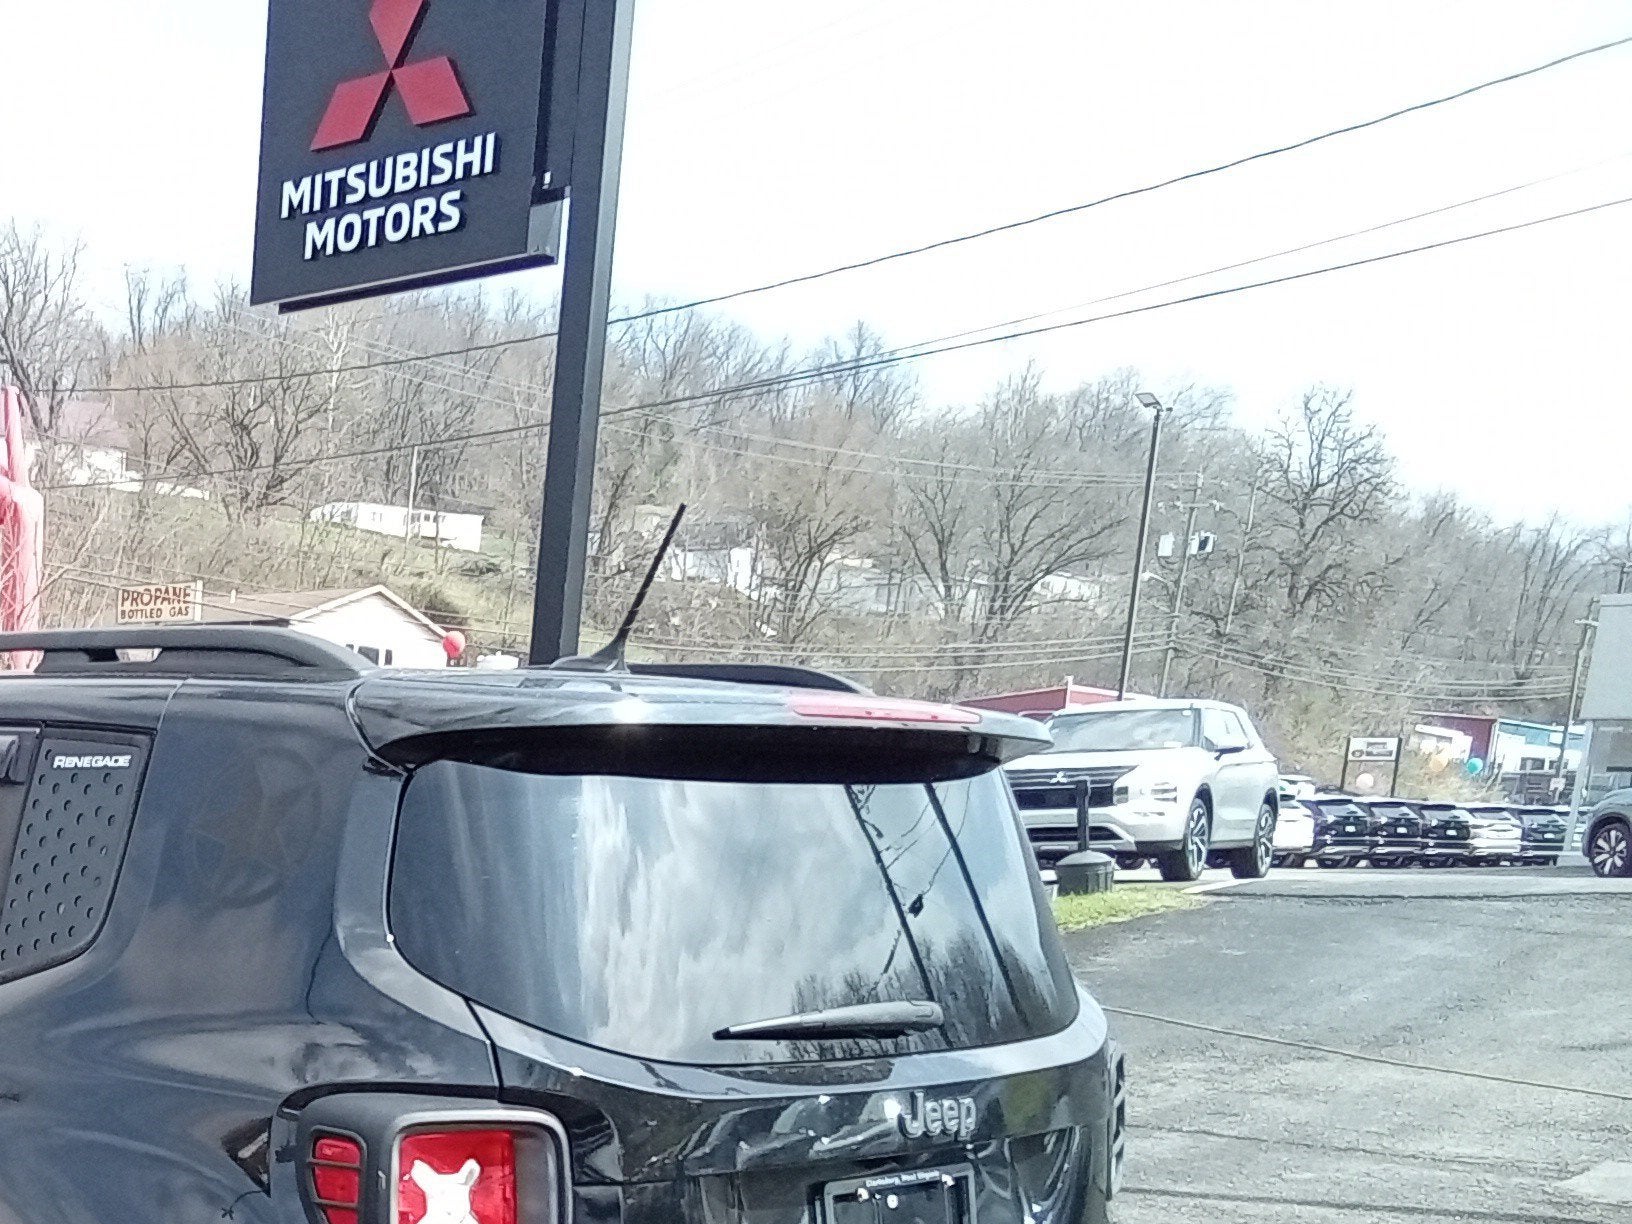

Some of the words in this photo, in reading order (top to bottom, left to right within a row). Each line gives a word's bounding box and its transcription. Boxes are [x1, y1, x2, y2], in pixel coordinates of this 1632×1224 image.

[280, 132, 496, 219] MITSUBISHI
[304, 189, 462, 260] MOTORS
[120, 586, 192, 608] PROPANE
[120, 607, 163, 620] BOTTLED
[169, 605, 190, 618] GAS
[52, 754, 132, 769] RENEGADE
[899, 1089, 977, 1142] Jeep
